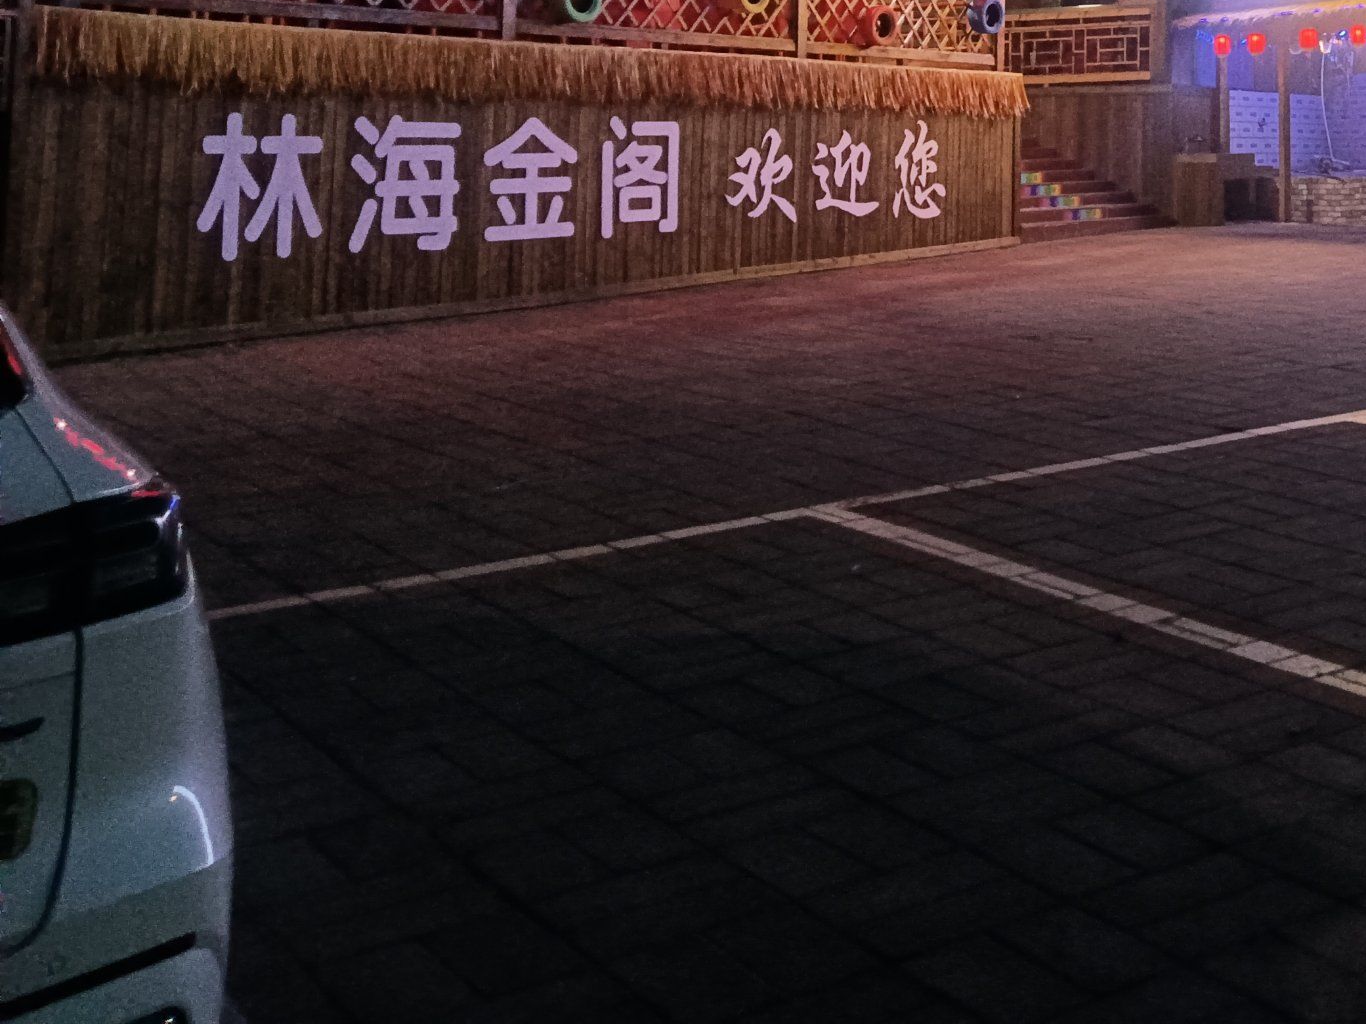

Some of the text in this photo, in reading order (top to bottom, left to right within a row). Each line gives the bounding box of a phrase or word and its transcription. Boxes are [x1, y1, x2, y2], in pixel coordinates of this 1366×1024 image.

[197, 112, 947, 261] 林海金阁 欢迎您
